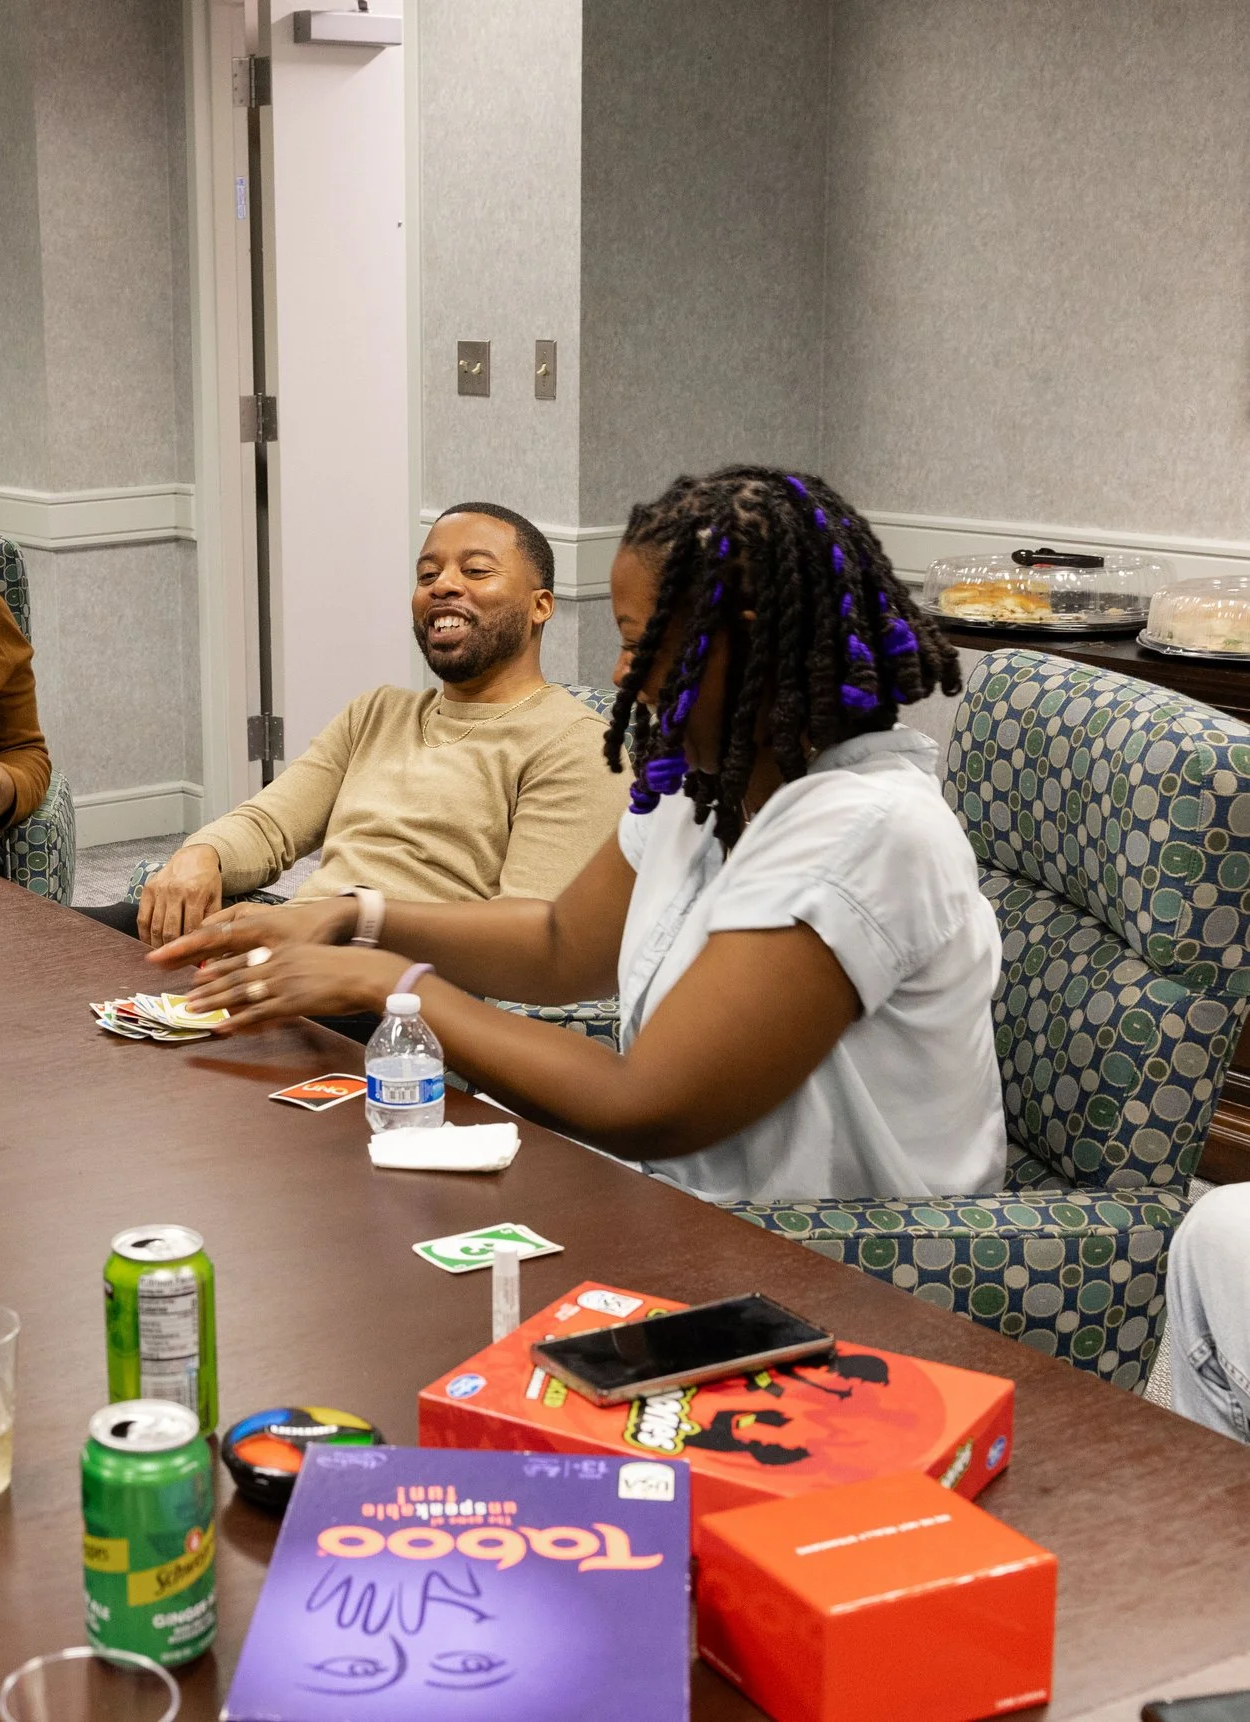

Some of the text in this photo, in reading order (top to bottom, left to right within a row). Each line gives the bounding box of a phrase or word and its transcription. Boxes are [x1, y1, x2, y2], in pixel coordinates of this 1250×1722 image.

[301, 1083, 350, 1096] UNO
[396, 1485, 458, 1504] fun!
[316, 1523, 664, 1572] Taboo
